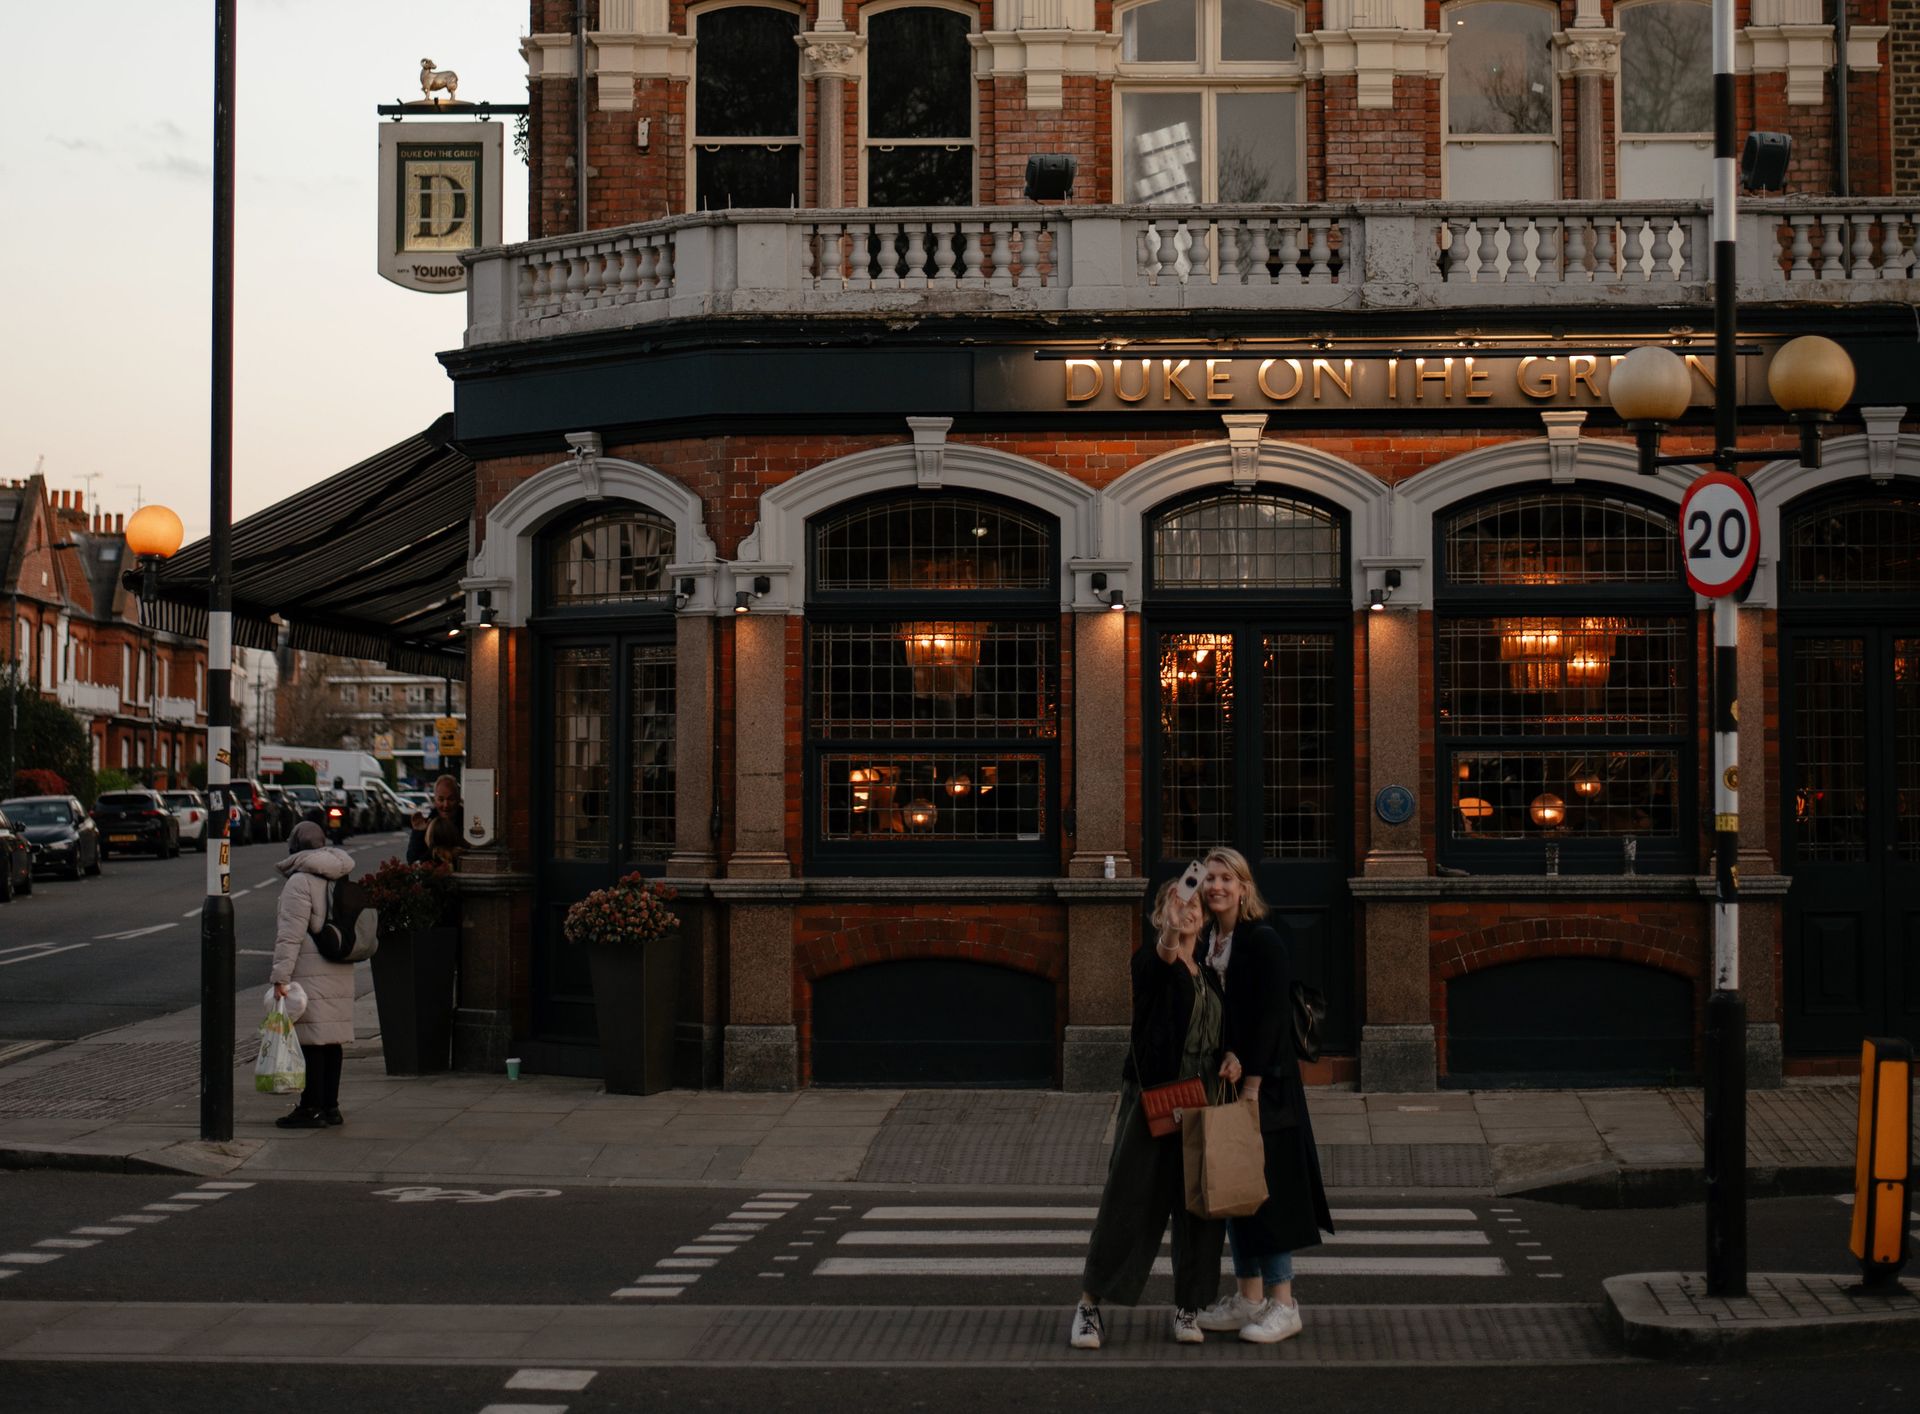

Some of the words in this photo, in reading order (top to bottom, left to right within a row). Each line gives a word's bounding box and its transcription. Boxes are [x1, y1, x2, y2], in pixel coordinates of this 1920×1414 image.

[400, 150, 422, 158] DUKE
[423, 150, 436, 158] ON
[438, 150, 453, 158] THE
[453, 149, 480, 158] GREEN
[412, 264, 465, 277] YOUNG'S
[1065, 357, 1234, 401] DUKE
[1258, 357, 1352, 401] ON
[1688, 508, 1746, 559] 20
